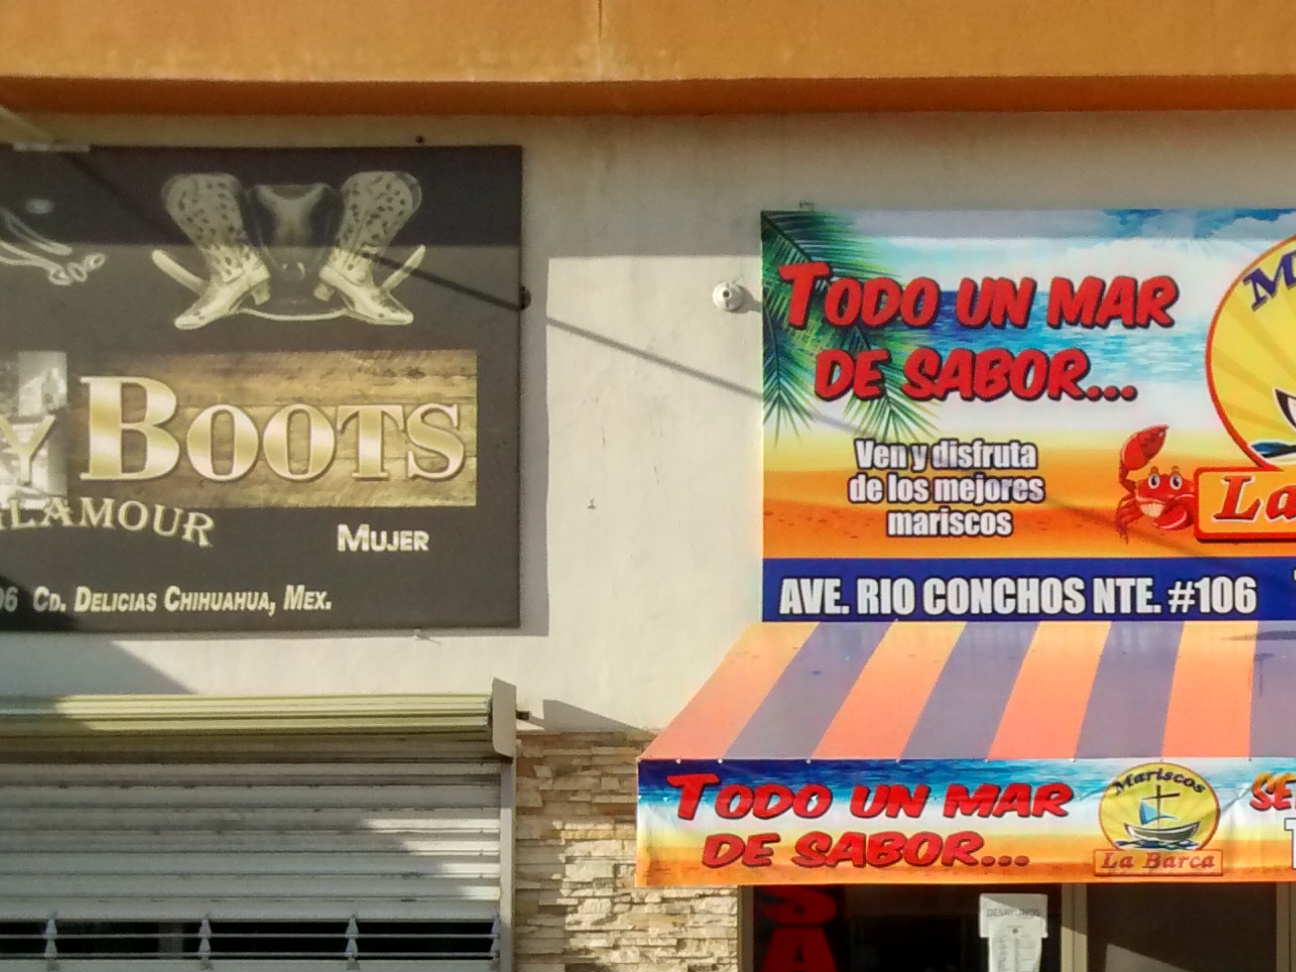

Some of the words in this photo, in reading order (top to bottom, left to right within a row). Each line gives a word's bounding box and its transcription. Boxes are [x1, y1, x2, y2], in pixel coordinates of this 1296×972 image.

[779, 261, 940, 329] TODO
[955, 276, 1036, 329] UN
[1046, 276, 1179, 329] MAR
[814, 348, 891, 401] DE
[902, 347, 1138, 401] SABOR...
[80, 376, 466, 482] BOOTS
[853, 438, 907, 470] Ven
[910, 445, 931, 472] y
[932, 438, 1038, 470] disfruta
[848, 473, 884, 502] de
[887, 473, 931, 502] los
[933, 475, 1045, 504] mejores
[0, 496, 215, 548] LAMOUR
[887, 508, 1013, 538] mariscos
[779, 577, 850, 617] AVE.
[857, 577, 917, 617] RIO
[922, 577, 1086, 617] CONCHOS
[1093, 577, 1162, 617] NTE.
[1167, 575, 1259, 616] #106
[667, 773, 833, 821] TODO
[850, 784, 933, 820] UN
[944, 783, 1074, 819] MAR
[1112, 768, 1205, 796] Mariscos
[702, 833, 781, 868] DE
[791, 831, 1030, 868] SABOR...
[1100, 852, 1134, 869] La
[1142, 852, 1216, 869] Barca
